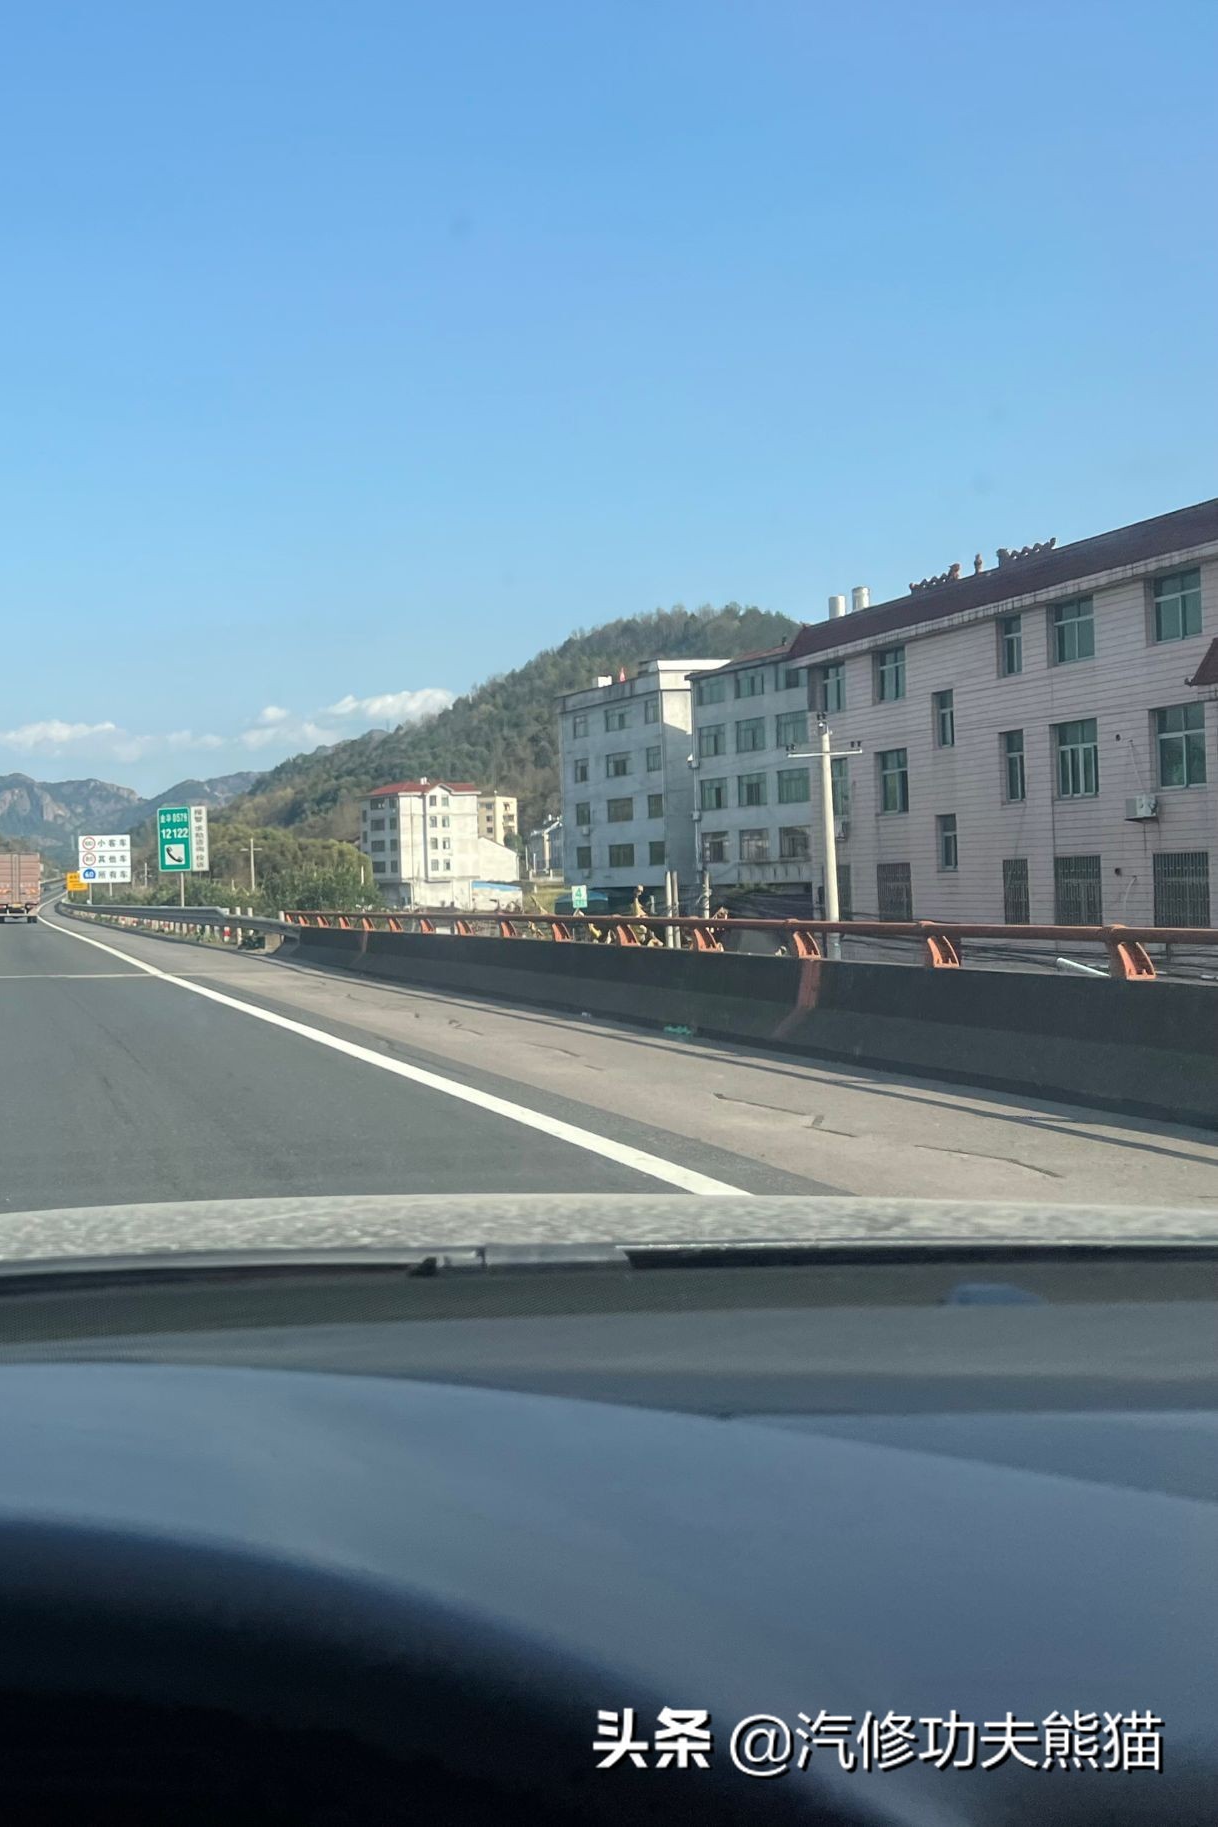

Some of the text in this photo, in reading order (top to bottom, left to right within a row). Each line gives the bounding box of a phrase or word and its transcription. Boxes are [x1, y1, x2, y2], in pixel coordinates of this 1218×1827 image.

[160, 827, 189, 839] 12122
[97, 838, 127, 848] 小客车
[98, 854, 127, 864] 其他车
[98, 870, 128, 880] 所有车
